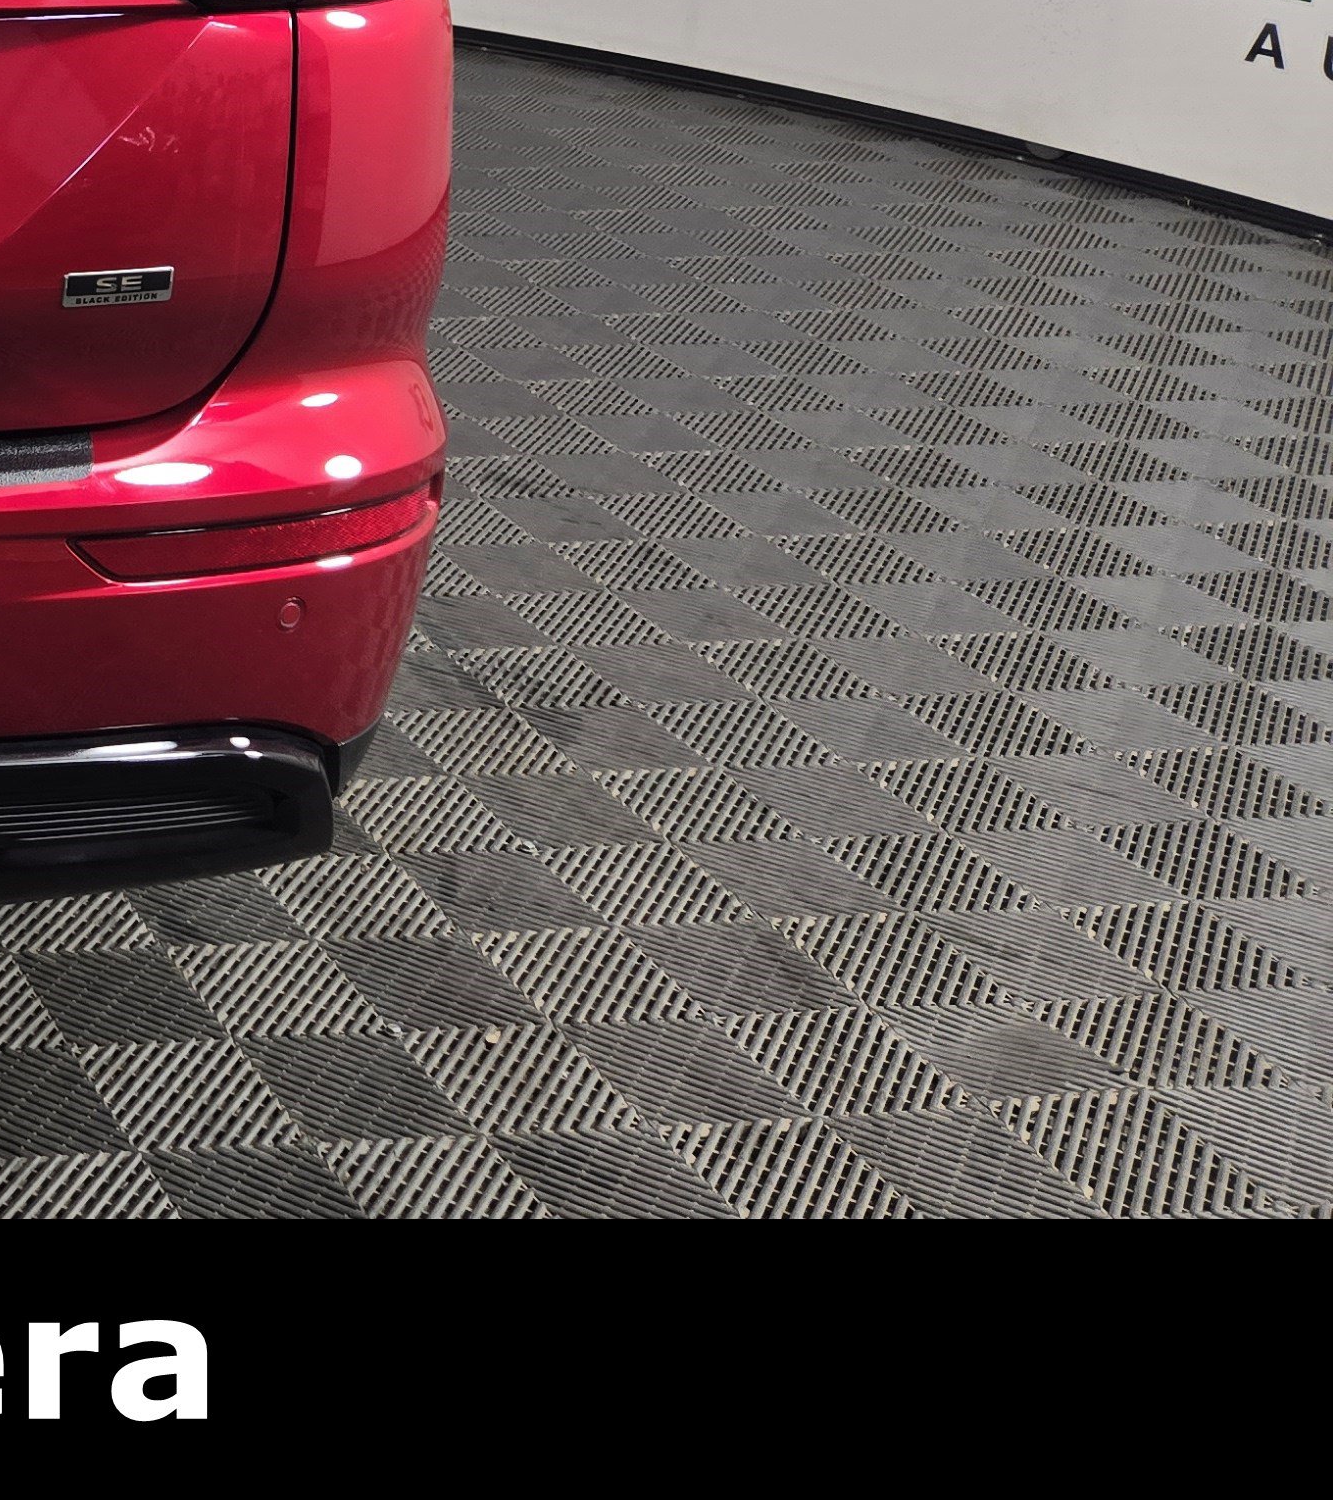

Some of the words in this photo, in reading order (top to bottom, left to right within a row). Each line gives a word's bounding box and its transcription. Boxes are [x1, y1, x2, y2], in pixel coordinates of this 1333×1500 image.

[1244, 22, 1333, 82] A
[95, 275, 143, 293] SE
[75, 294, 110, 305] BLACK
